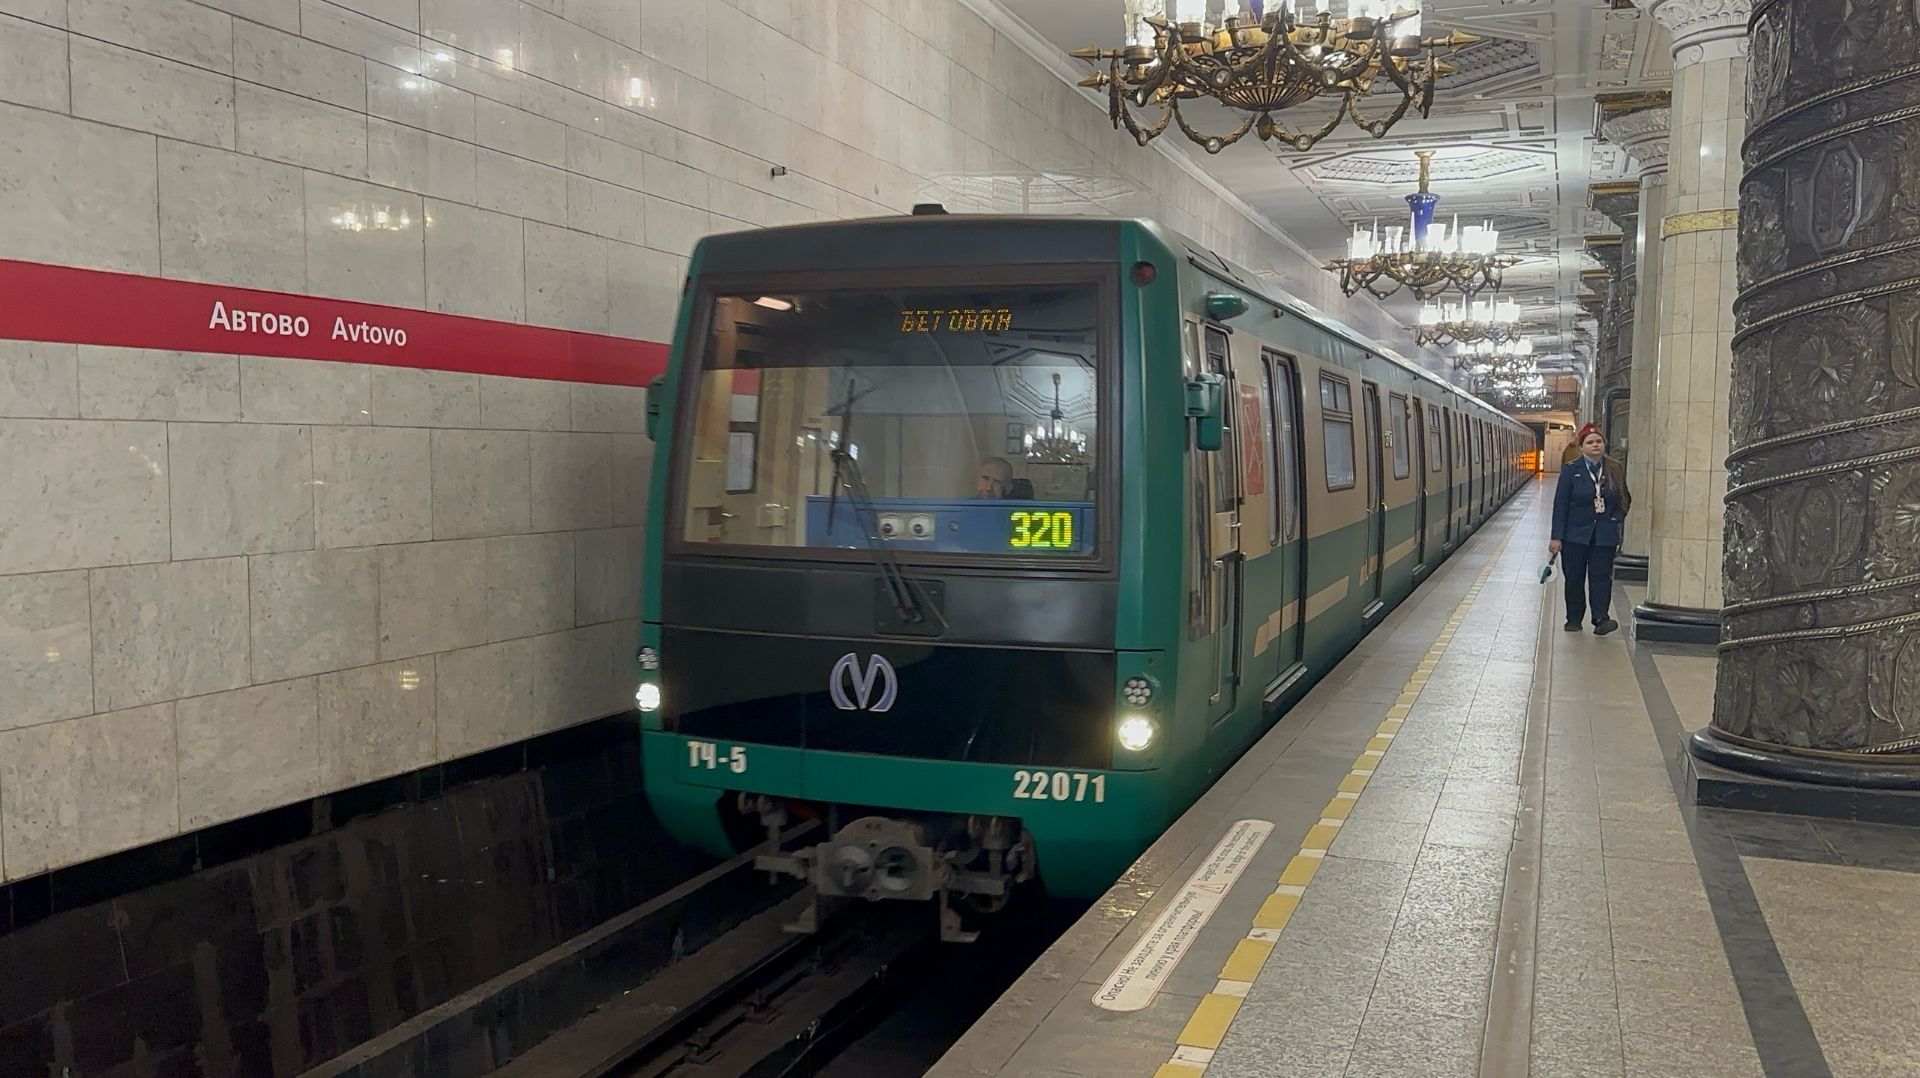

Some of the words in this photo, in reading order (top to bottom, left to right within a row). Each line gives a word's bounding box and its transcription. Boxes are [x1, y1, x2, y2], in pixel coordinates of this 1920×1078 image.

[331, 316, 407, 348] Avtovo
[1010, 511, 1072, 548] 320
[1013, 770, 1105, 803] 22071
[1165, 941, 1181, 955] края
[1101, 974, 1132, 1001] Опасно!
[1121, 963, 1138, 975] Не
[1134, 940, 1159, 966] заходите
[1152, 932, 1164, 940] за
